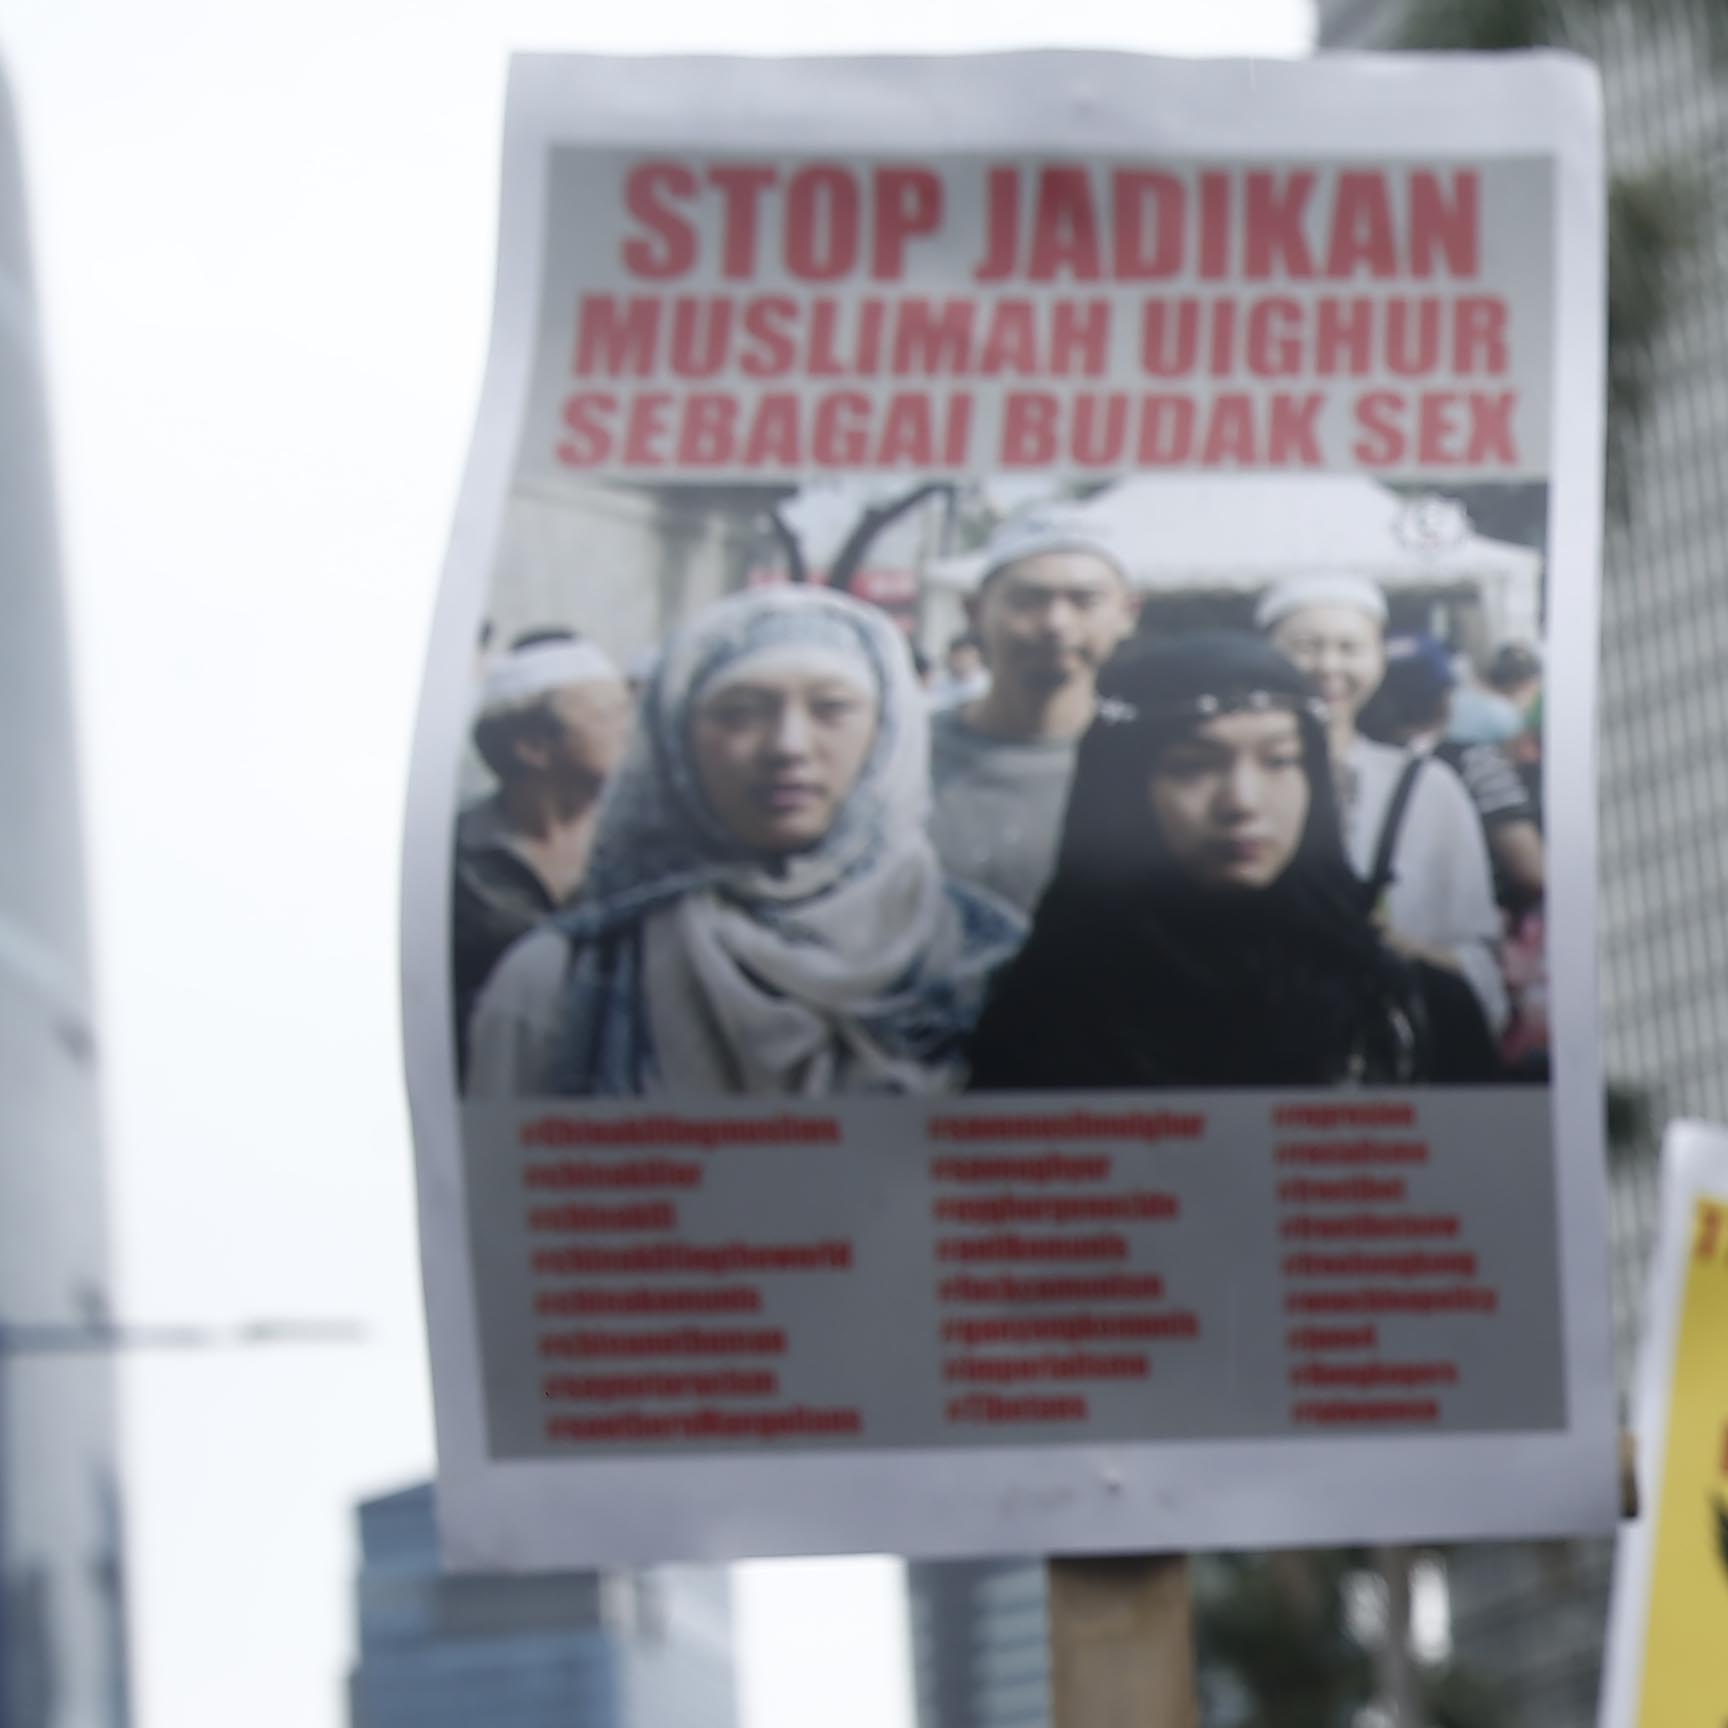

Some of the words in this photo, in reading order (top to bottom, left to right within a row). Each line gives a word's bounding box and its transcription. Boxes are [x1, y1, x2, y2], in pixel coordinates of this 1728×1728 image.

[620, 158, 946, 285] STOP
[972, 163, 1481, 285] JADIKAN
[572, 293, 1113, 381] MUSLIMAH
[1139, 293, 1510, 380] UIGHUR
[554, 388, 976, 470] SEBAGAI
[998, 388, 1327, 469] BUDAK
[1352, 388, 1520, 468] SEX
